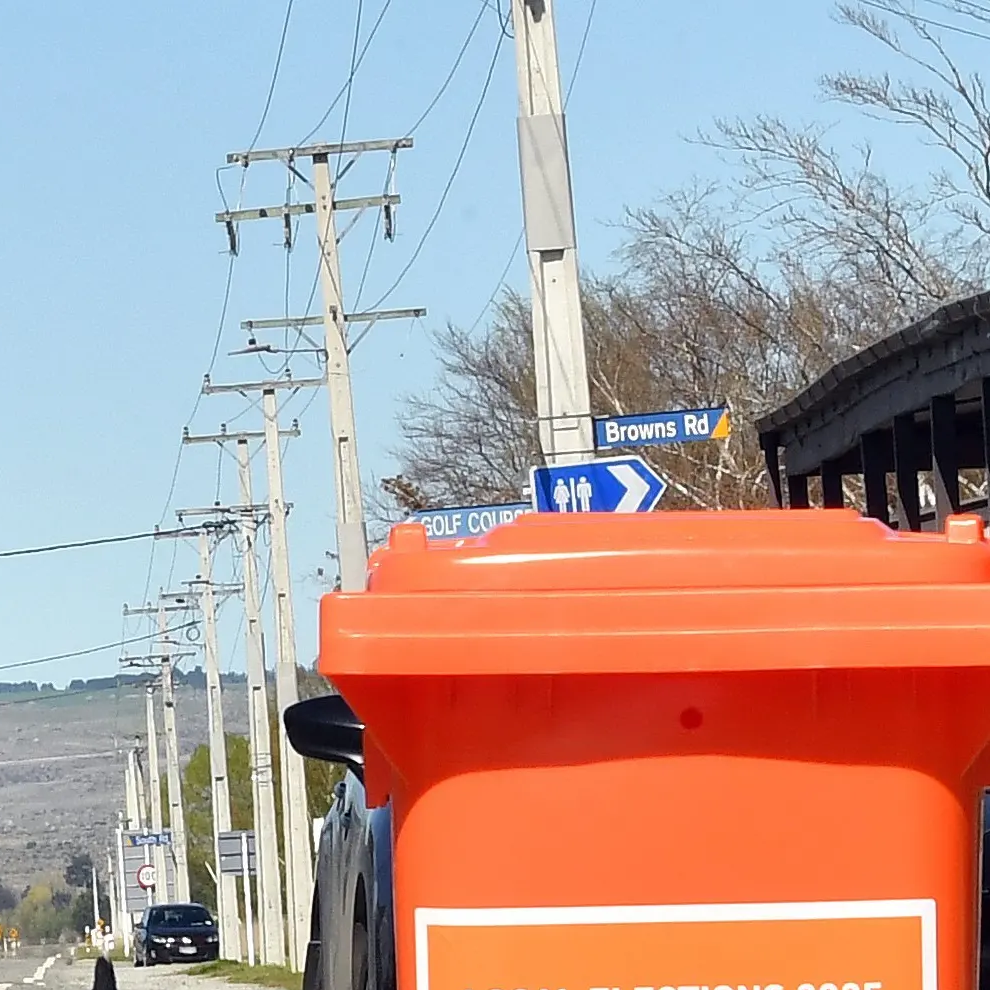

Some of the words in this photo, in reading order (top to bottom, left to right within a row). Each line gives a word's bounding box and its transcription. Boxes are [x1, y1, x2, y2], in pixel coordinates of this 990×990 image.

[605, 421, 677, 443] Browns
[683, 414, 710, 436] Rd
[421, 513, 462, 536] GOLF
